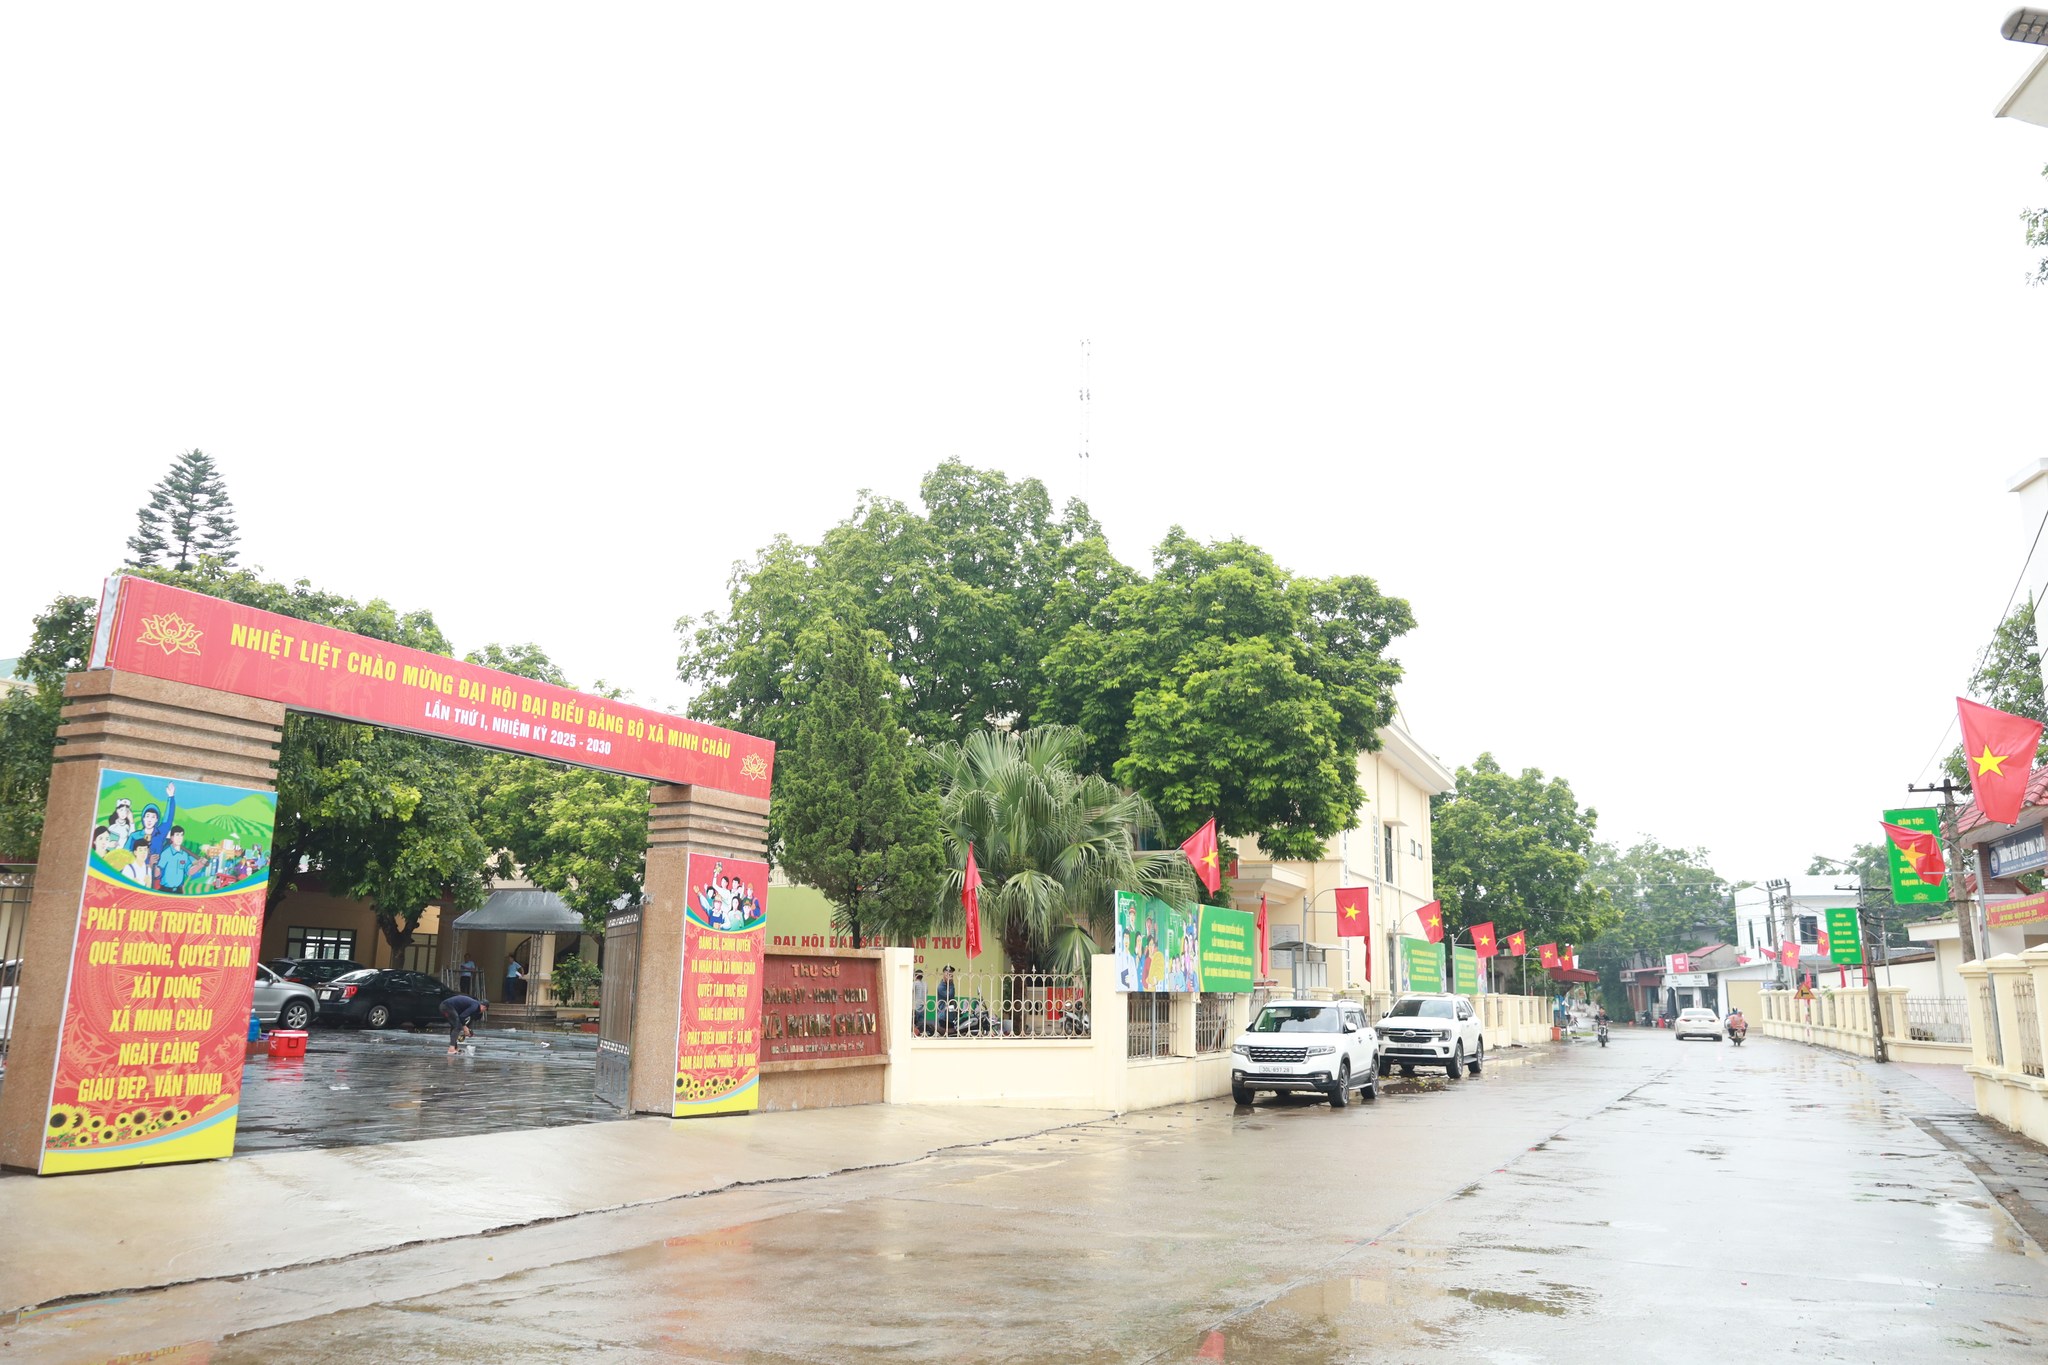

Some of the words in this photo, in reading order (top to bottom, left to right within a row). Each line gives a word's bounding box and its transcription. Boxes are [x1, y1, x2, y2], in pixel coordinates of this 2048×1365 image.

[230, 623, 294, 660] NHIỆT
[300, 640, 342, 671] LIỆT
[347, 652, 397, 681] CHÀO
[402, 665, 454, 695] MỪNG
[458, 678, 486, 705] ĐẠI
[491, 686, 518, 712] HỘI
[522, 694, 547, 719] ĐẠI
[551, 699, 584, 725] BIỂU
[587, 707, 623, 734] ĐẢNG
[627, 719, 644, 742] BỘ
[648, 724, 664, 743] XÃ
[668, 729, 698, 751] MINH
[702, 738, 731, 759] CHÂU
[425, 699, 450, 721] LẦN
[454, 708, 478, 726] THỨ
[480, 714, 488, 731] I,
[492, 716, 530, 738] NHIỆM
[532, 724, 548, 742] KỲ
[550, 730, 576, 748] 2025
[586, 738, 611, 755] 2030
[86, 904, 126, 931] PHÁT
[128, 909, 158, 933] HUY
[161, 906, 213, 934] TRUYỀN
[215, 908, 258, 936] THỐNG
[89, 937, 120, 966] QUÊ
[122, 942, 175, 968] HƯƠNG,
[178, 938, 222, 968] QUYẾT
[224, 942, 252, 967] TÂM
[932, 934, 963, 949] THỨ
[131, 972, 162, 998] XÂY
[163, 975, 202, 1003] DỰNG
[109, 1005, 131, 1032] XÃ
[133, 1009, 173, 1032] MINH
[175, 1004, 213, 1031] CHÂU
[786, 1014, 831, 1038] MINH
[834, 1008, 877, 1036] CHÂU
[118, 1038, 159, 1066] NGÀY
[161, 1037, 200, 1064] CÀNG
[78, 1073, 115, 1102] GIÀU
[117, 1076, 149, 1104] ĐẸP,
[154, 1070, 183, 1098] VĂN
[185, 1072, 222, 1096] MINH
